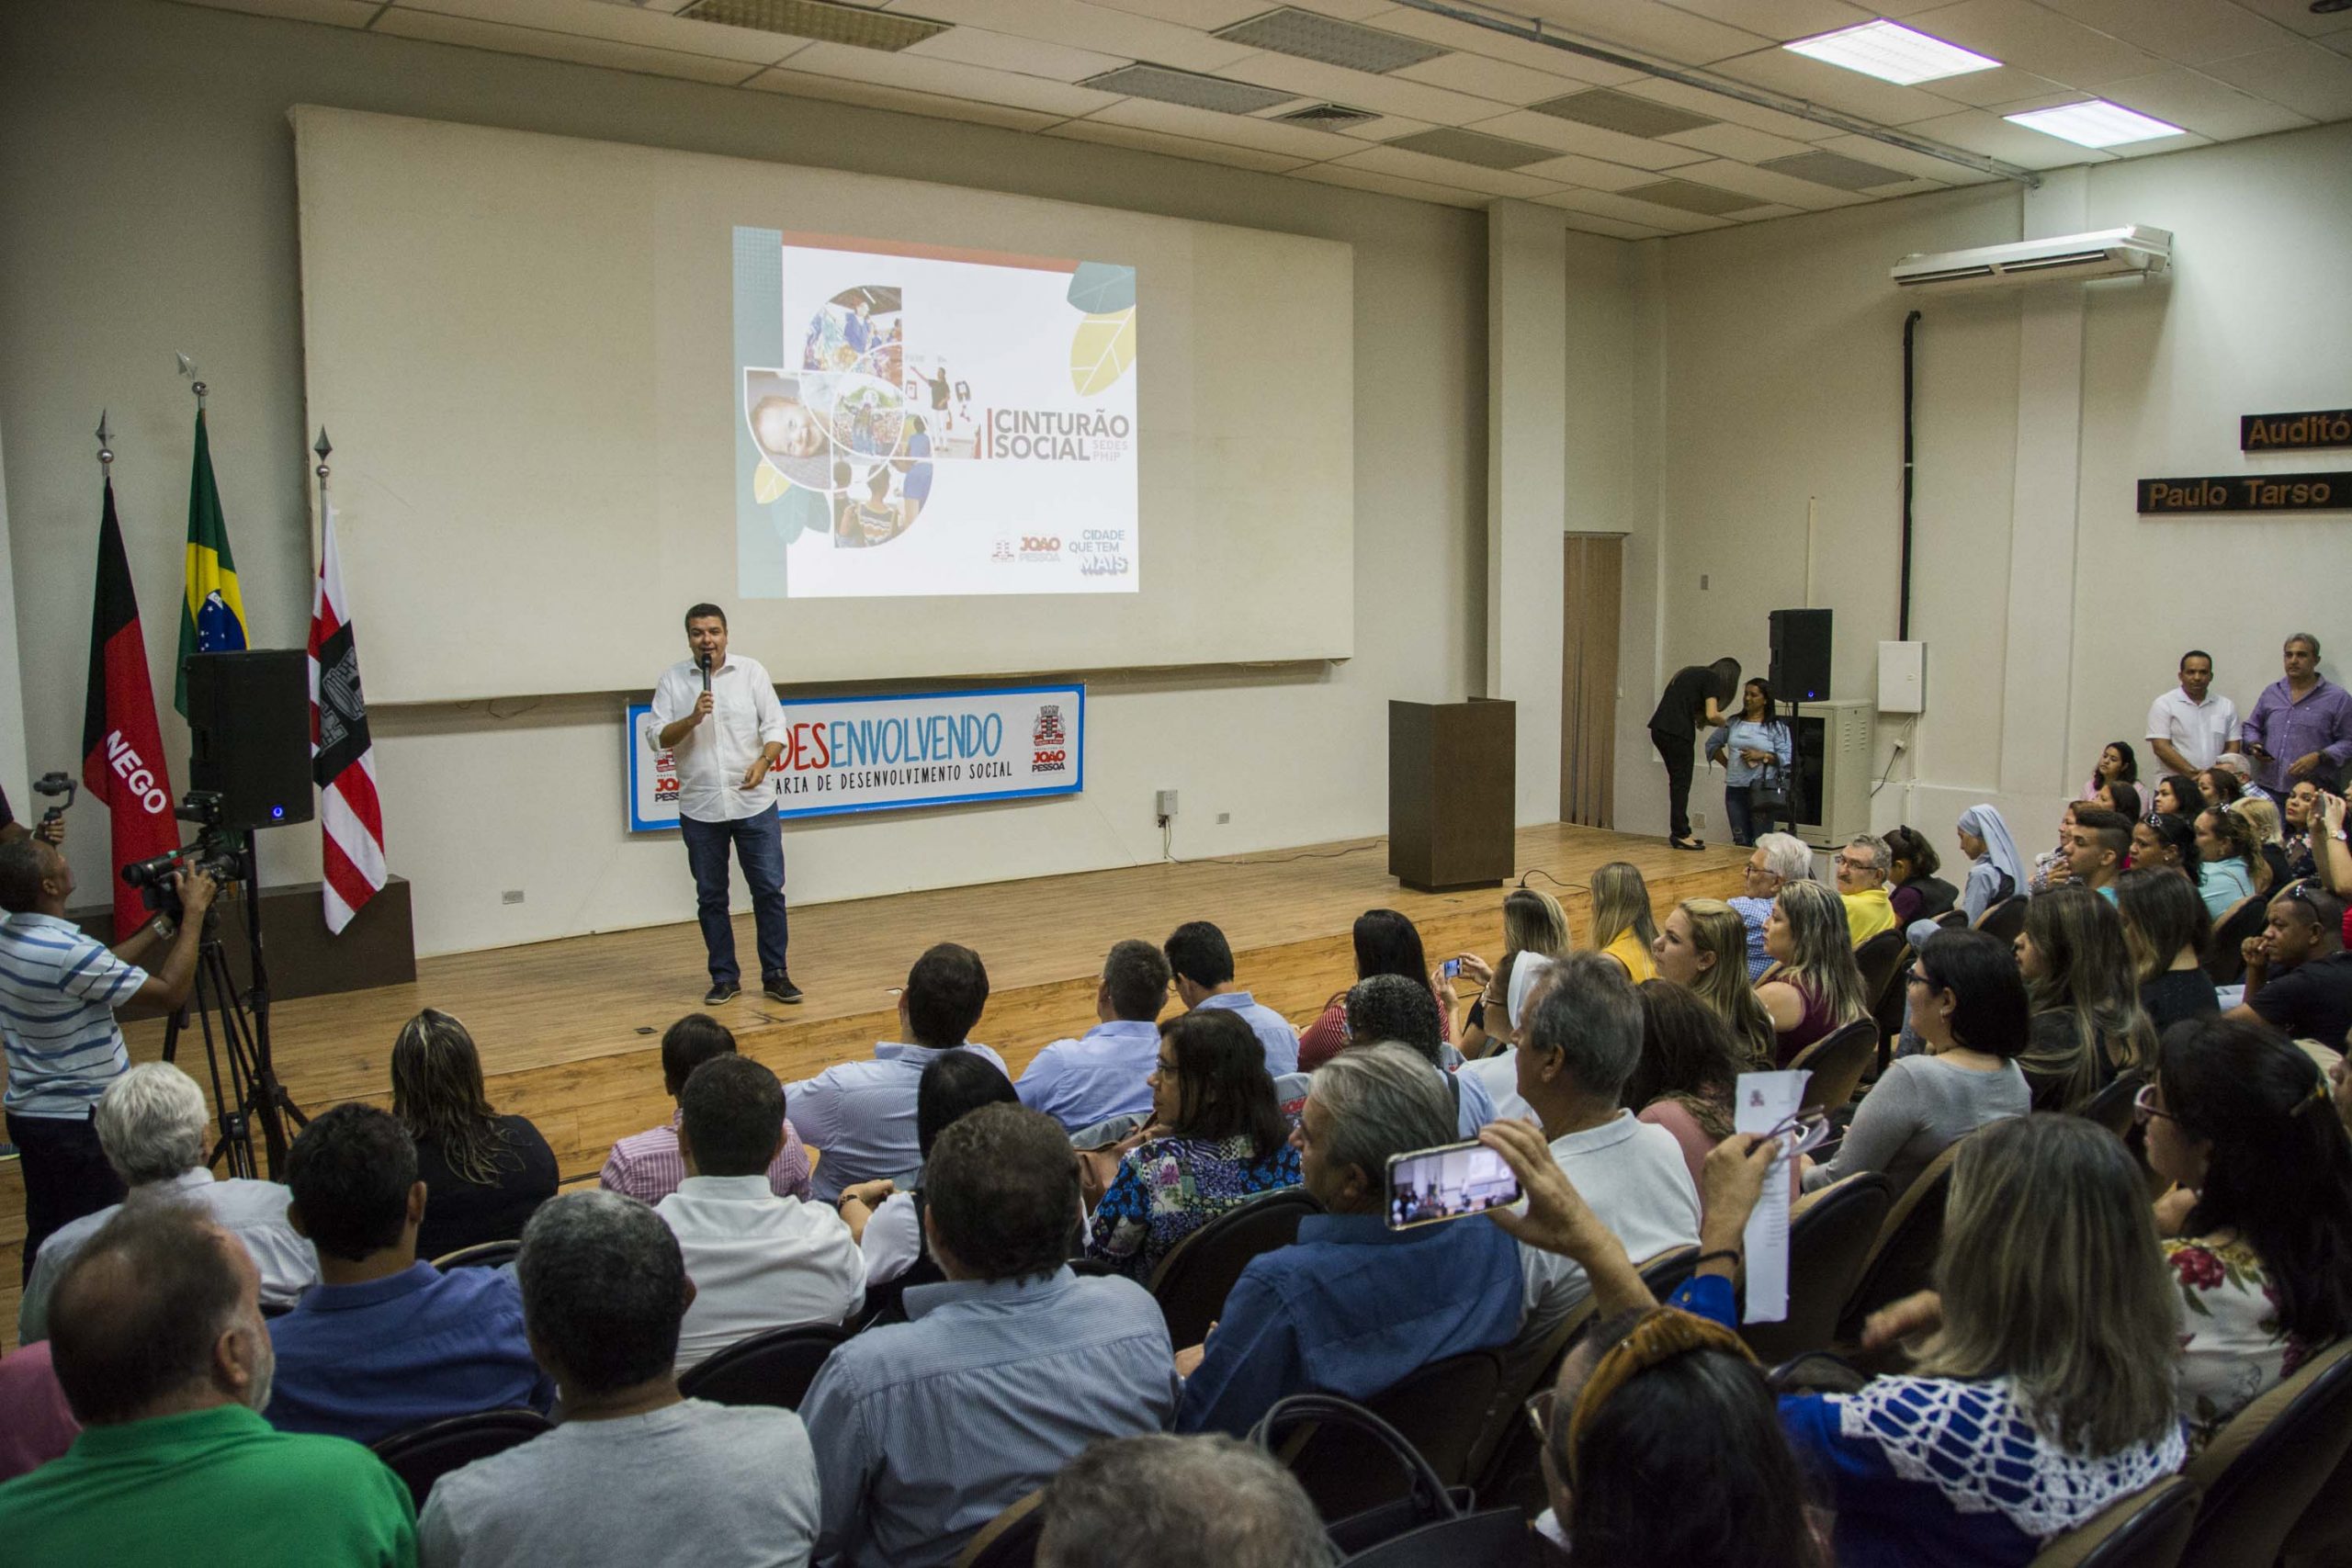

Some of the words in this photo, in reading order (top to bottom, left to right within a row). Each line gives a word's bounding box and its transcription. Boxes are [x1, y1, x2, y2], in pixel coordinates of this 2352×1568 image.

[994, 409, 1130, 438] CINTURÃO
[995, 434, 1091, 461] SOCIAL
[1092, 440, 1128, 450] SEDES
[2150, 479, 2227, 509] Paulo
[2243, 479, 2331, 505] Tarso
[1069, 541, 1093, 553] QUE
[1095, 541, 1119, 553] TEM
[1082, 529, 1125, 540] CIDADE
[1080, 555, 1128, 575] MAIS
[770, 713, 1002, 772] DESENVOLVENDO
[107, 729, 167, 814] NEGO
[818, 774, 831, 791] DE
[841, 764, 961, 790] DESENVOLVIMENTO
[969, 761, 1012, 780] SOCIAL
[1032, 762, 1066, 773] PESSOA
